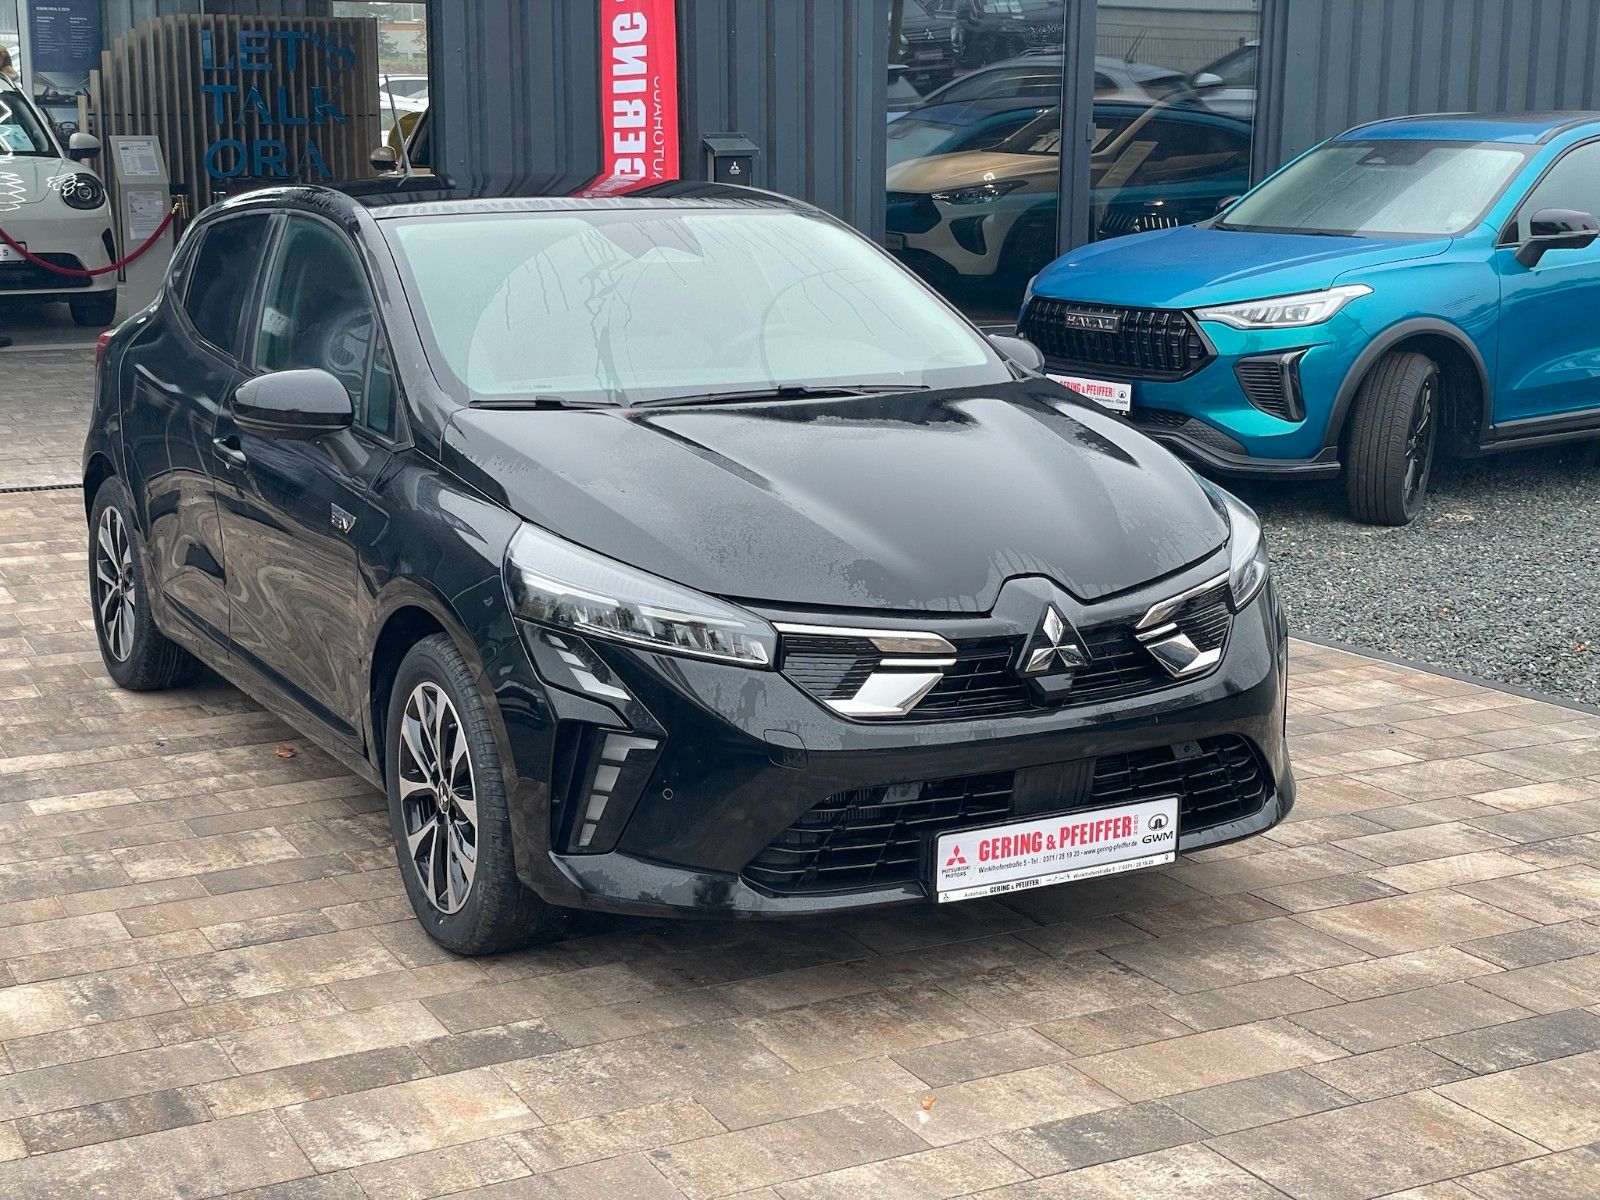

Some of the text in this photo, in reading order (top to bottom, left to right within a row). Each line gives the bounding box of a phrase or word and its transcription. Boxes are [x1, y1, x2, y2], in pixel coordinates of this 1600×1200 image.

[201, 29, 356, 72] LET'S
[201, 84, 347, 125] TALK
[204, 138, 332, 179] ORA
[1087, 384, 1113, 397] PFEIFFER
[978, 815, 1132, 862] GERING & PFEIFFER
[1142, 831, 1173, 843] GWM
[945, 871, 967, 879] MOTORS
[989, 884, 1010, 893] GERING
[1015, 879, 1039, 889] PFEIFFER
